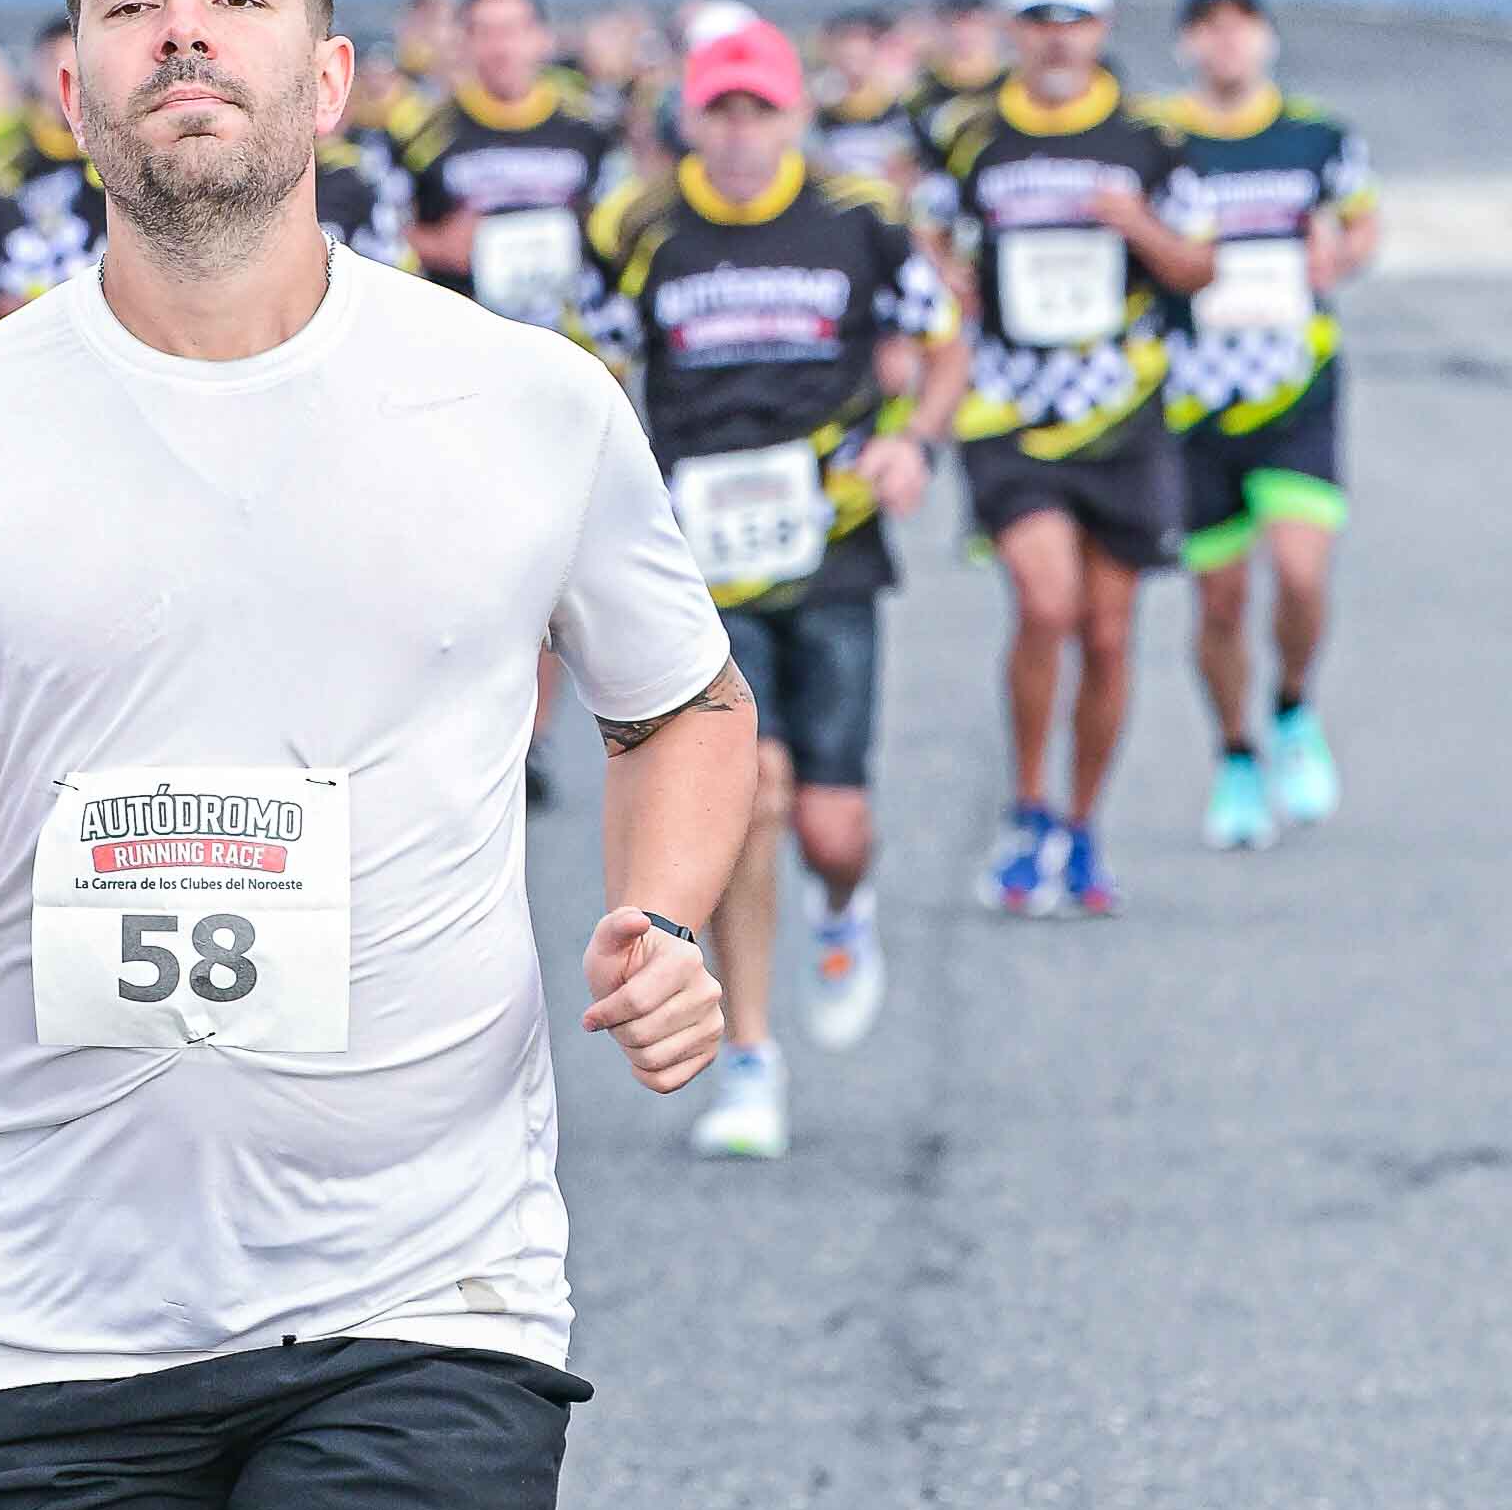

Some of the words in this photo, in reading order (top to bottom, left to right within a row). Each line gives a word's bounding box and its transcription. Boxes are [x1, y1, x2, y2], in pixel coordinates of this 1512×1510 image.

[80, 783, 303, 842] AUTÓDROMO
[113, 841, 205, 869] RUNNING
[211, 842, 264, 868] RACE
[75, 878, 89, 889] La
[91, 878, 137, 890] Carrera
[140, 877, 155, 890] de
[159, 877, 177, 890] los
[180, 878, 223, 890] Clubes
[225, 878, 245, 890] del
[248, 878, 303, 890] Noroeste
[118, 912, 258, 1003] 58
